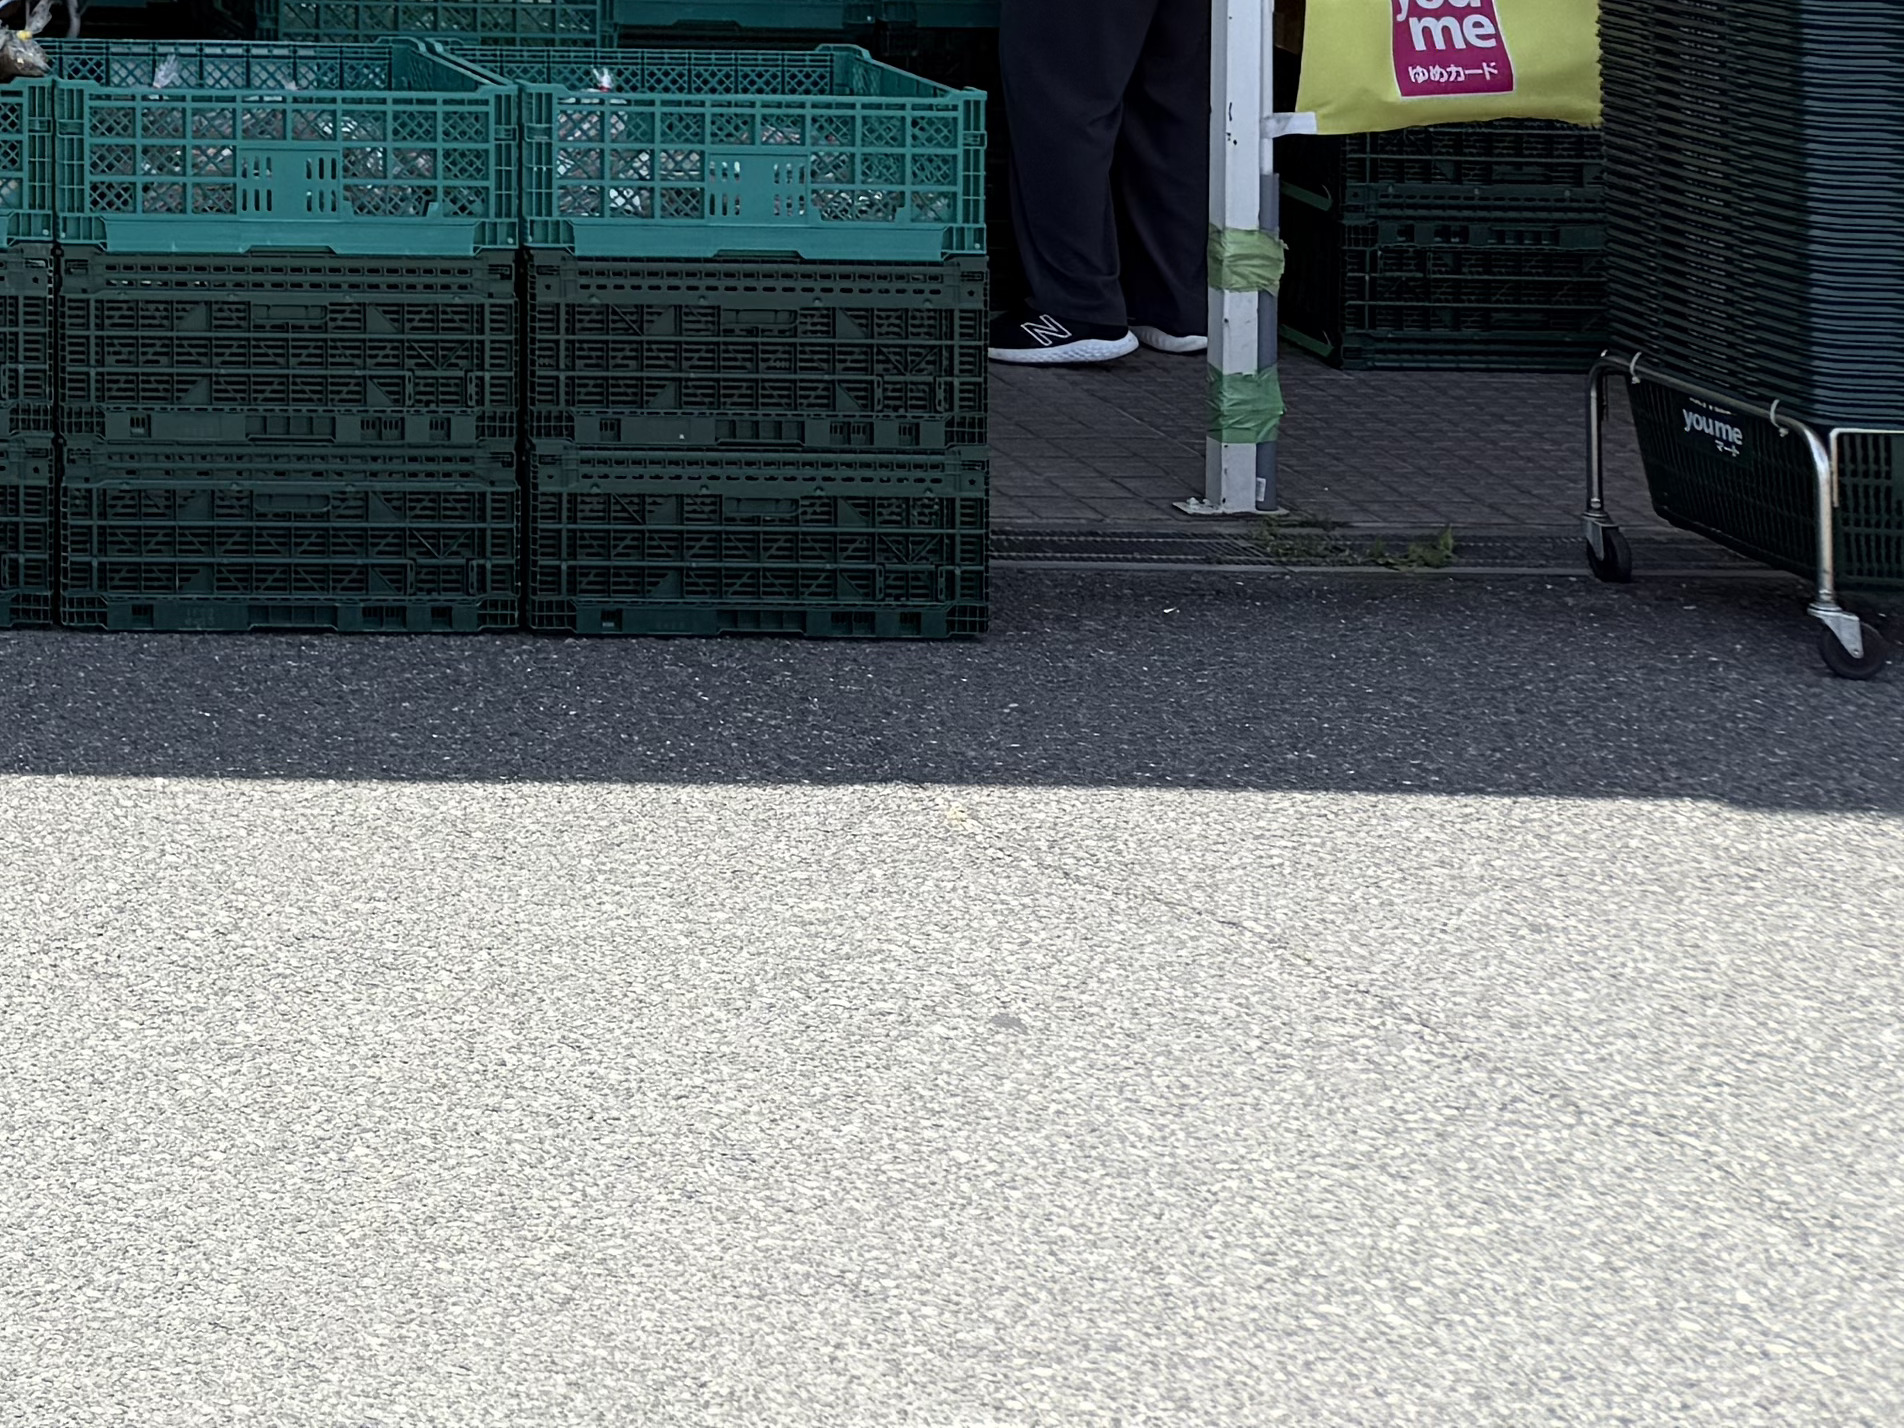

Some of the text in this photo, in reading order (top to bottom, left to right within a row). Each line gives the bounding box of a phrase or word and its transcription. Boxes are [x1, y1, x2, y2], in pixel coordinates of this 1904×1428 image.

[1408, 13, 1497, 52] me
[1407, 61, 1499, 84] ゆめカード
[1682, 408, 1743, 446] youme
